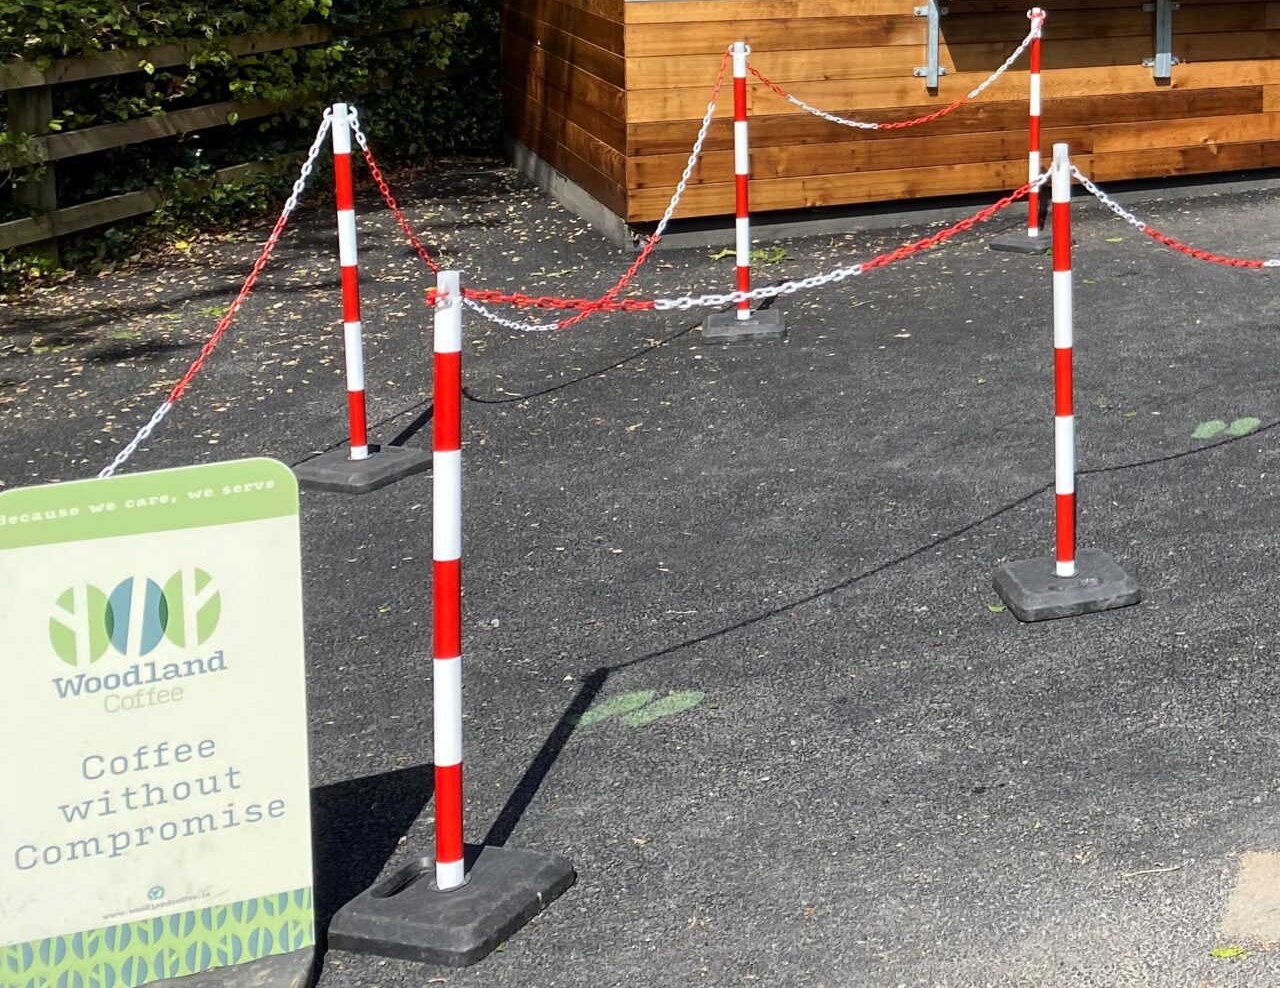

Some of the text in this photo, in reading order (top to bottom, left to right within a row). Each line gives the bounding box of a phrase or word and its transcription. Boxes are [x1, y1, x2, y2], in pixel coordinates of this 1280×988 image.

[88, 500, 116, 513] we
[125, 493, 177, 509] care,
[187, 487, 214, 500] we
[222, 479, 275, 496] serve
[52, 650, 228, 699] Woodland
[103, 685, 184, 714] Coffee
[81, 738, 216, 781] Coffee
[57, 766, 242, 823] without
[14, 798, 286, 871] Compromise
